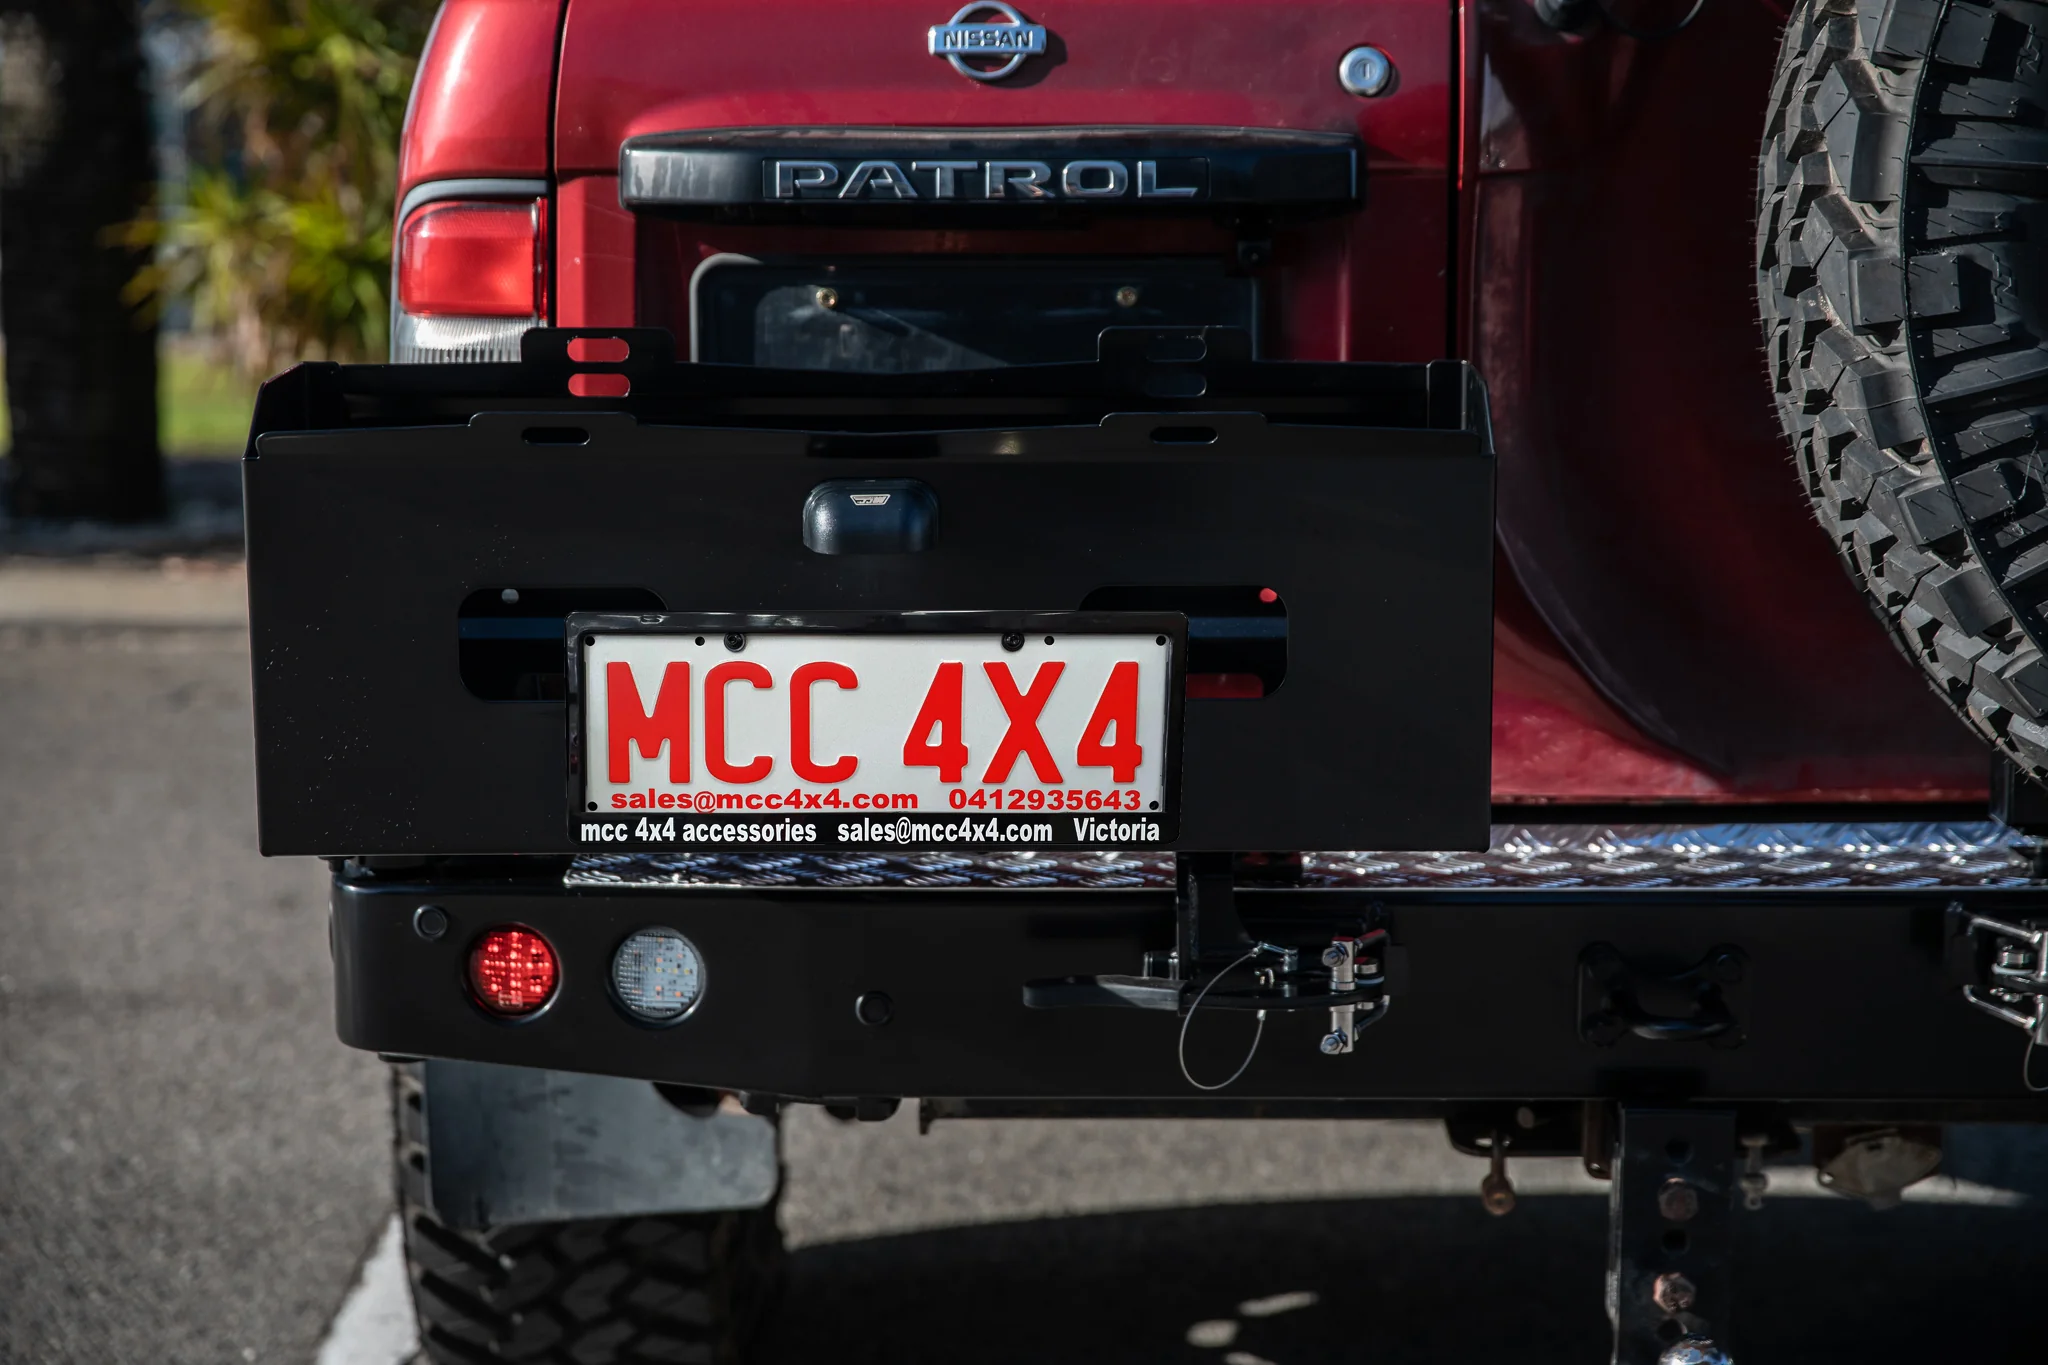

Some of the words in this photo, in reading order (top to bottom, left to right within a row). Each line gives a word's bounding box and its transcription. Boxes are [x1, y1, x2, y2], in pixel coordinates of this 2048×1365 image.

[944, 29, 1033, 50] NISSAN
[775, 159, 1199, 200] PATROL
[607, 661, 859, 784] MCC
[903, 661, 1143, 784] 4X4
[611, 788, 918, 813] sales@mcc4x4.com
[950, 788, 1141, 810] 0412935643
[580, 821, 628, 842] mcc
[635, 817, 676, 842] 4x4
[683, 817, 817, 842] accessories
[837, 816, 1053, 845] sales@mcc4x4.com
[1073, 817, 1160, 841] Victoria
